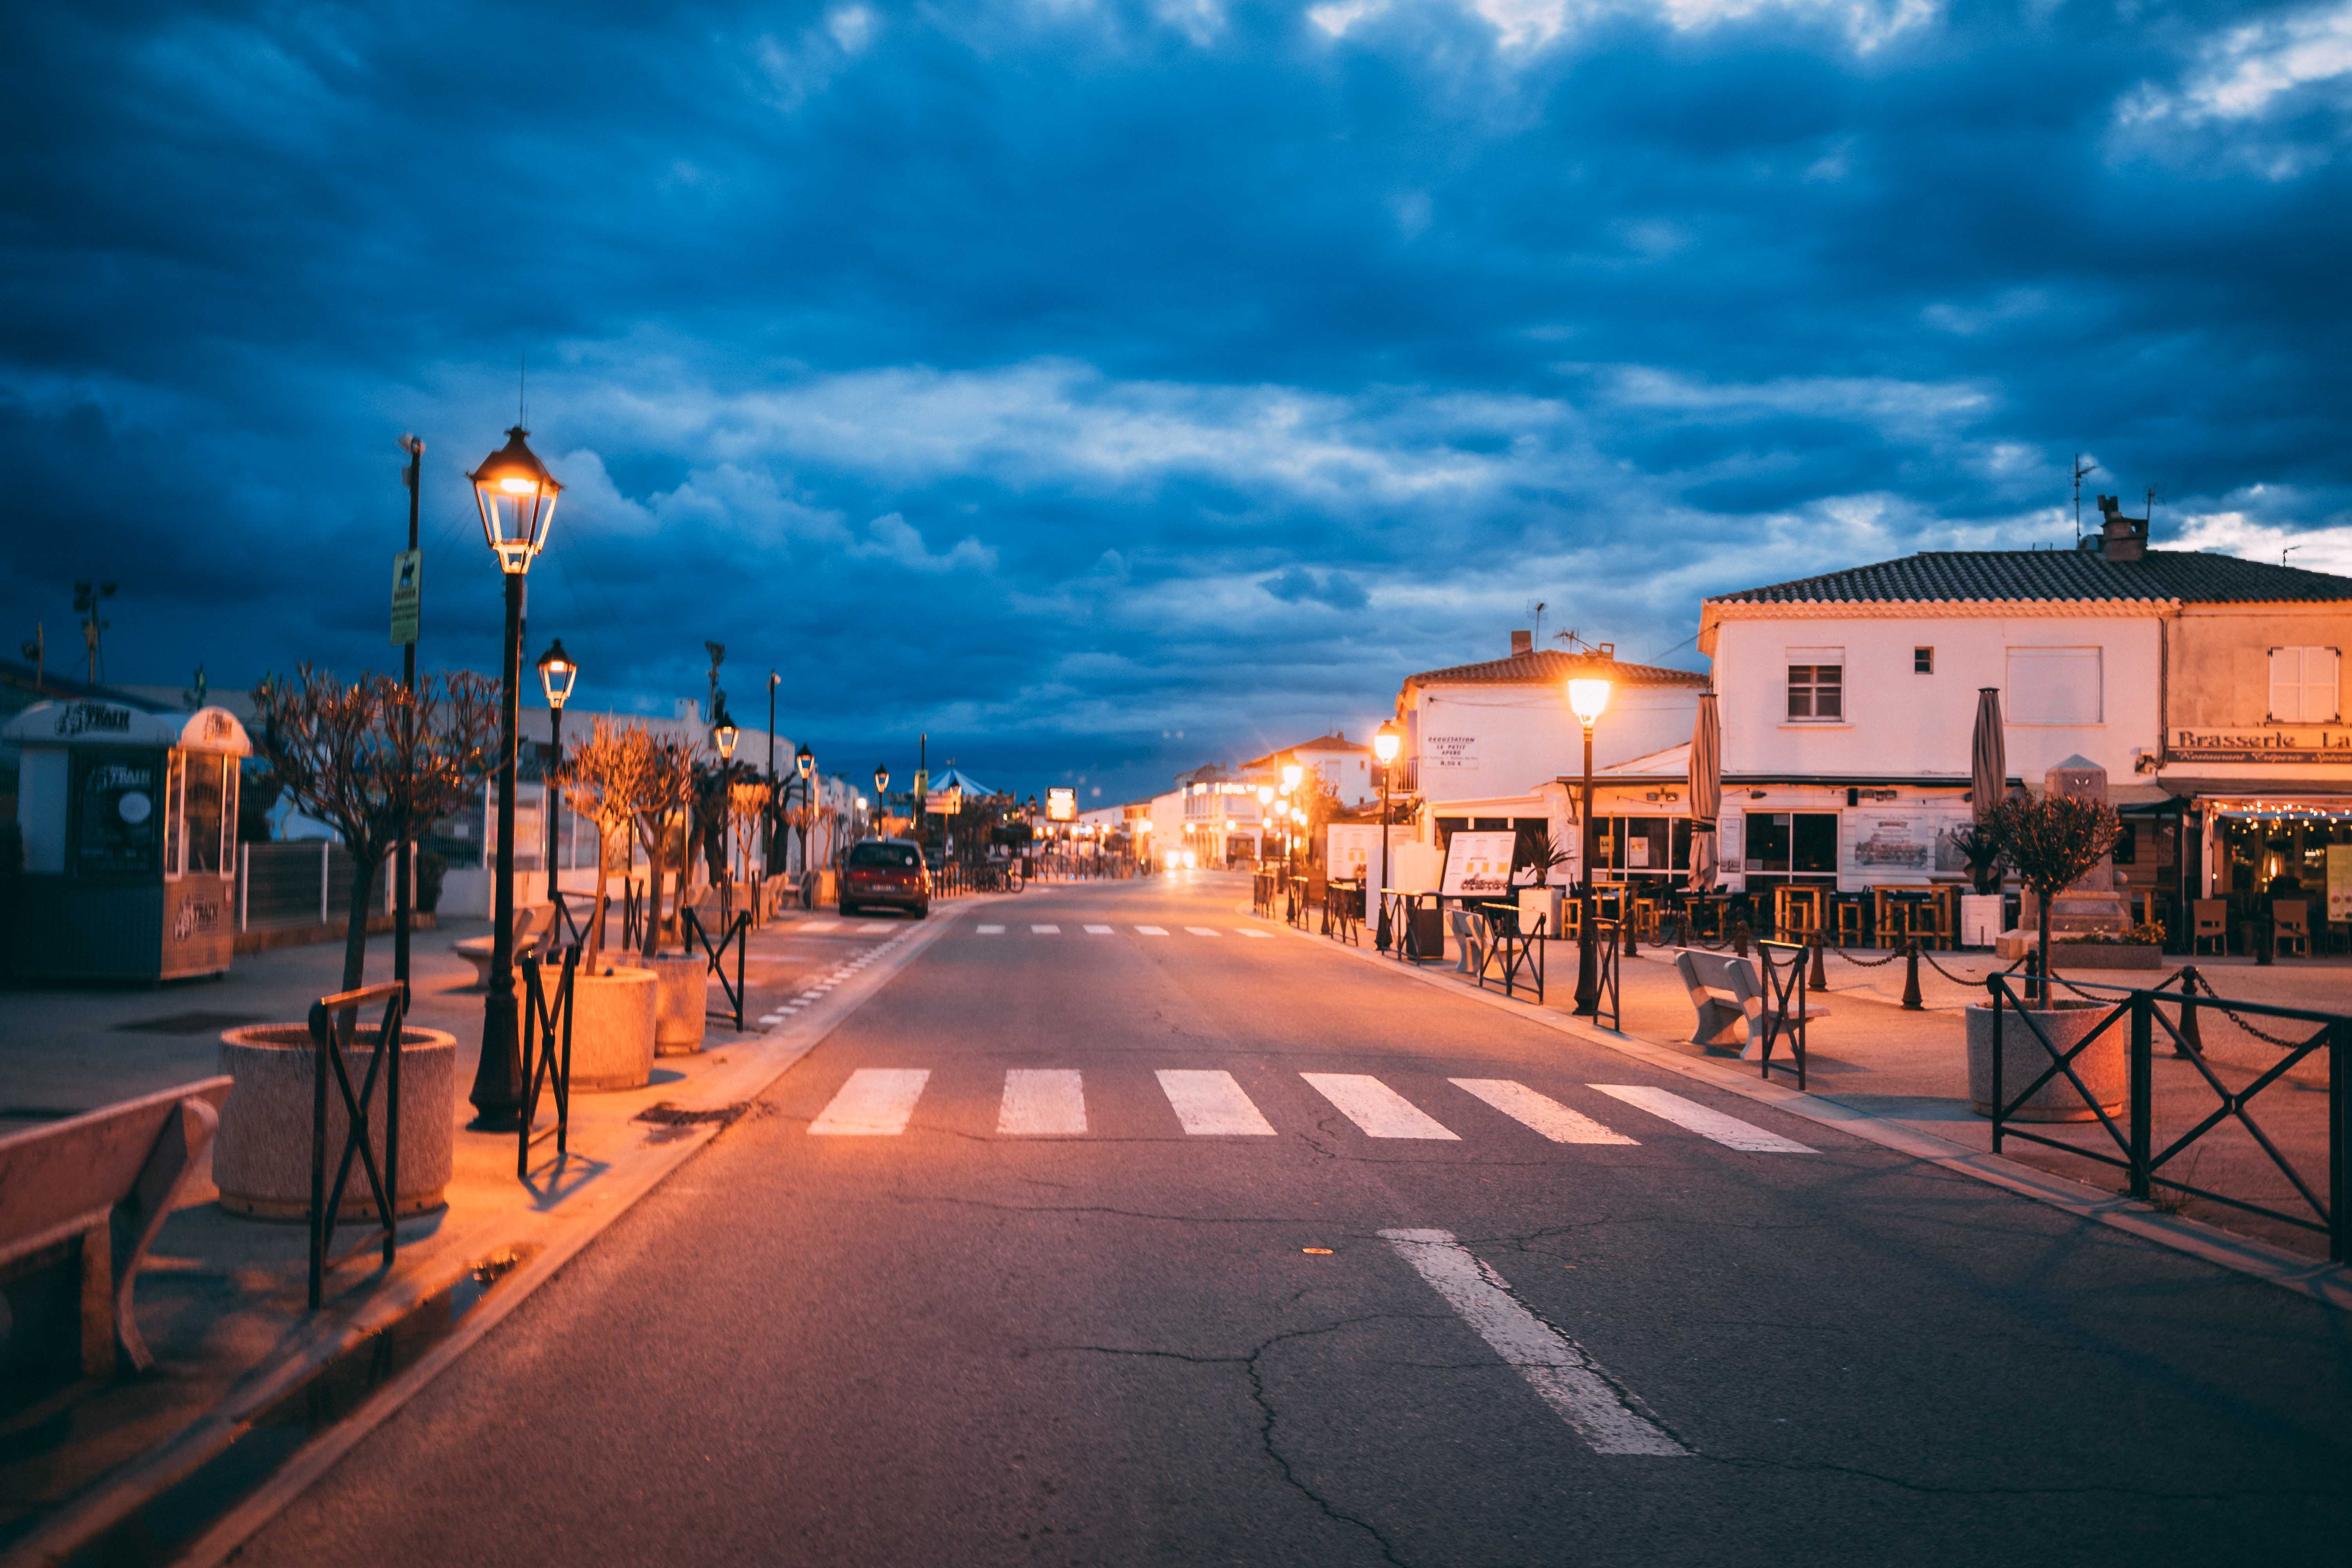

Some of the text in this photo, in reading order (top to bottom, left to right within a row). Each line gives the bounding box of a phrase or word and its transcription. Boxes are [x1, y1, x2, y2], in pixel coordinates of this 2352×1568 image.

[2179, 731, 2350, 748] Brasserie La
[2176, 751, 2246, 760] Restaurant
